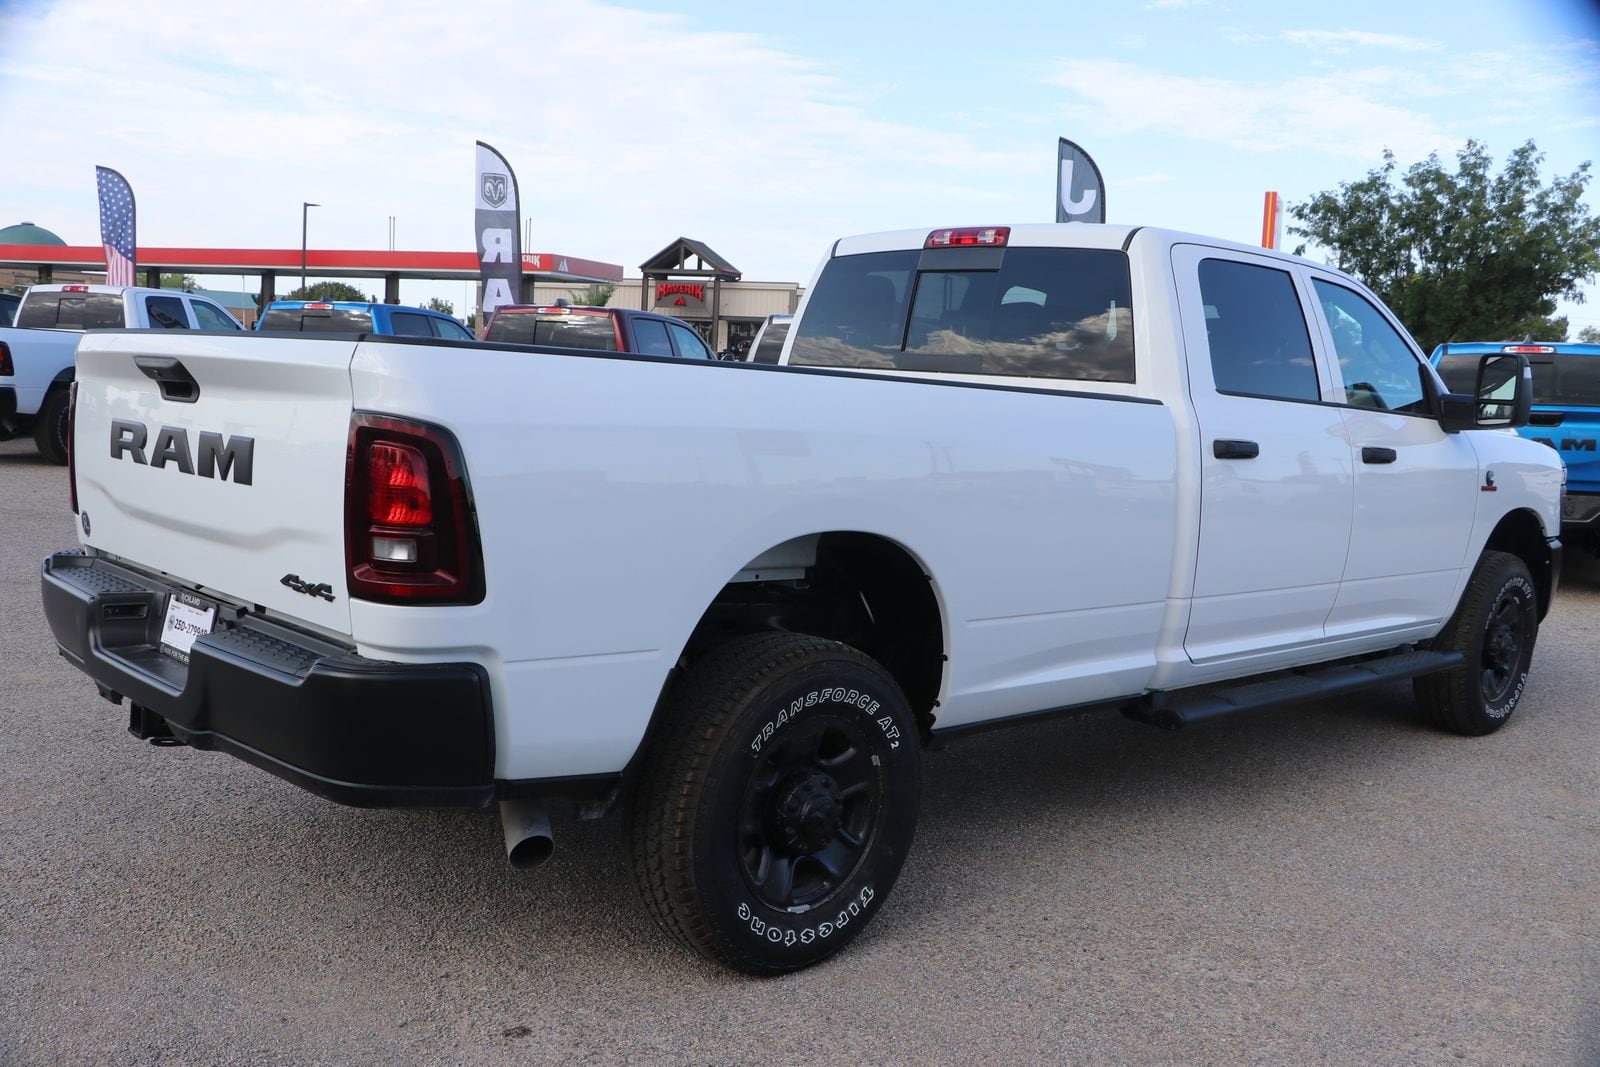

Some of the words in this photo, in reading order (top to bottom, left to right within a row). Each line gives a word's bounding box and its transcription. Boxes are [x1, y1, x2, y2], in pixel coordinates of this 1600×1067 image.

[521, 254, 540, 268] ERIK
[656, 283, 704, 302] MAVERIK
[110, 417, 255, 486] RAM
[751, 687, 881, 752] TRANSFORCE
